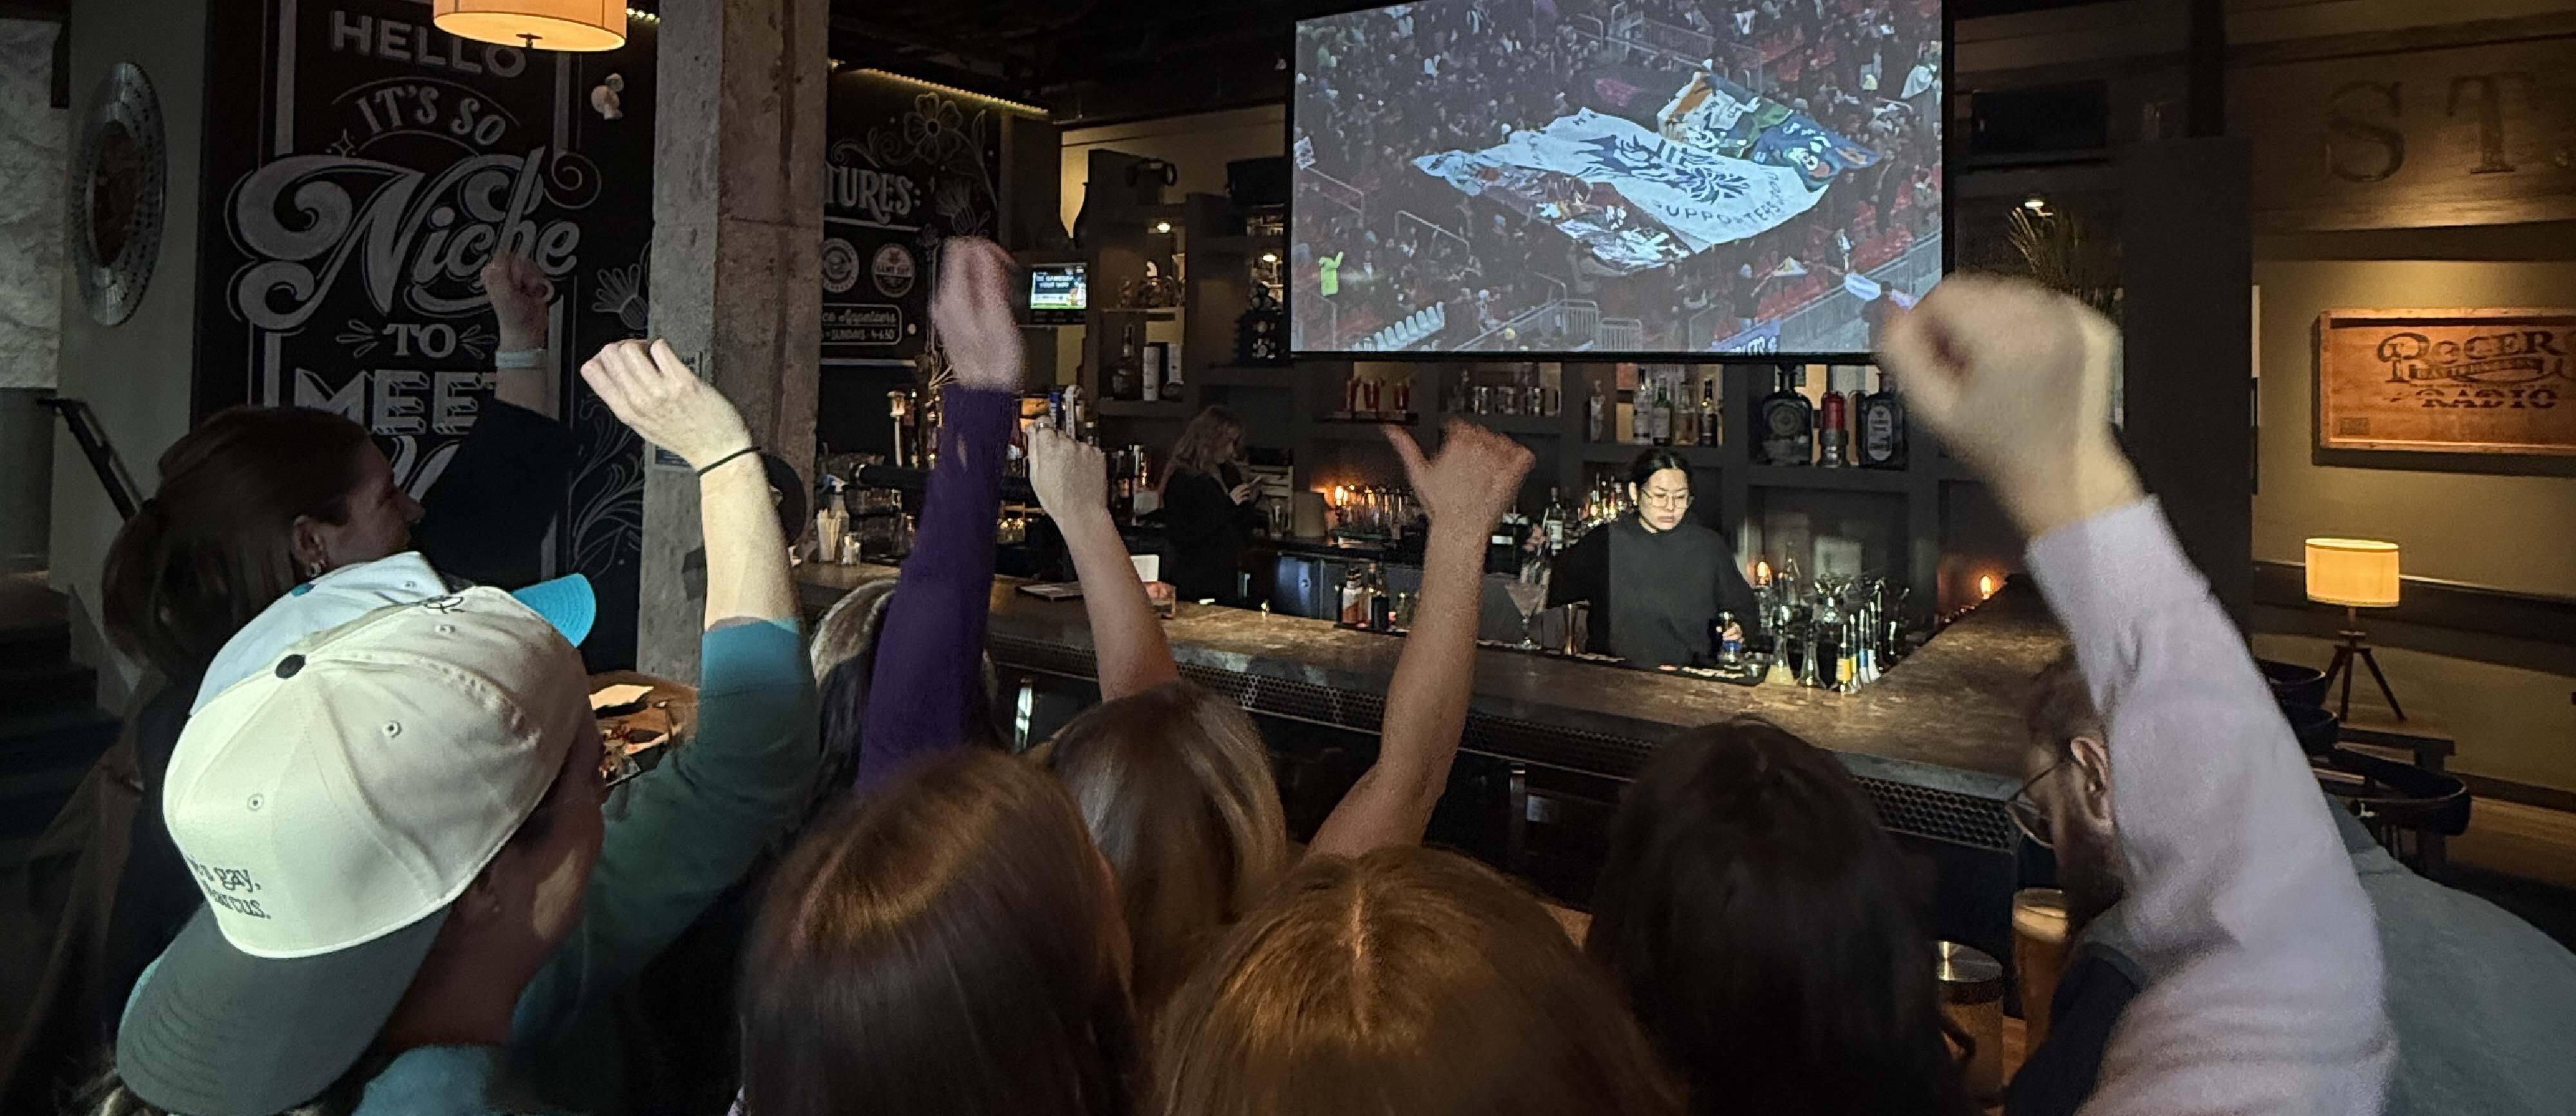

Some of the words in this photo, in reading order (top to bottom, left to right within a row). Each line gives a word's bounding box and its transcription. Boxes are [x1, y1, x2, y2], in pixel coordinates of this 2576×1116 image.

[329, 10, 526, 78] HELLO
[356, 84, 439, 133] IT'S
[453, 97, 506, 146] SO
[225, 146, 581, 331] Niche
[386, 323, 457, 358] TO
[294, 368, 496, 436] MEE
[2415, 388, 2557, 410] RADIO
